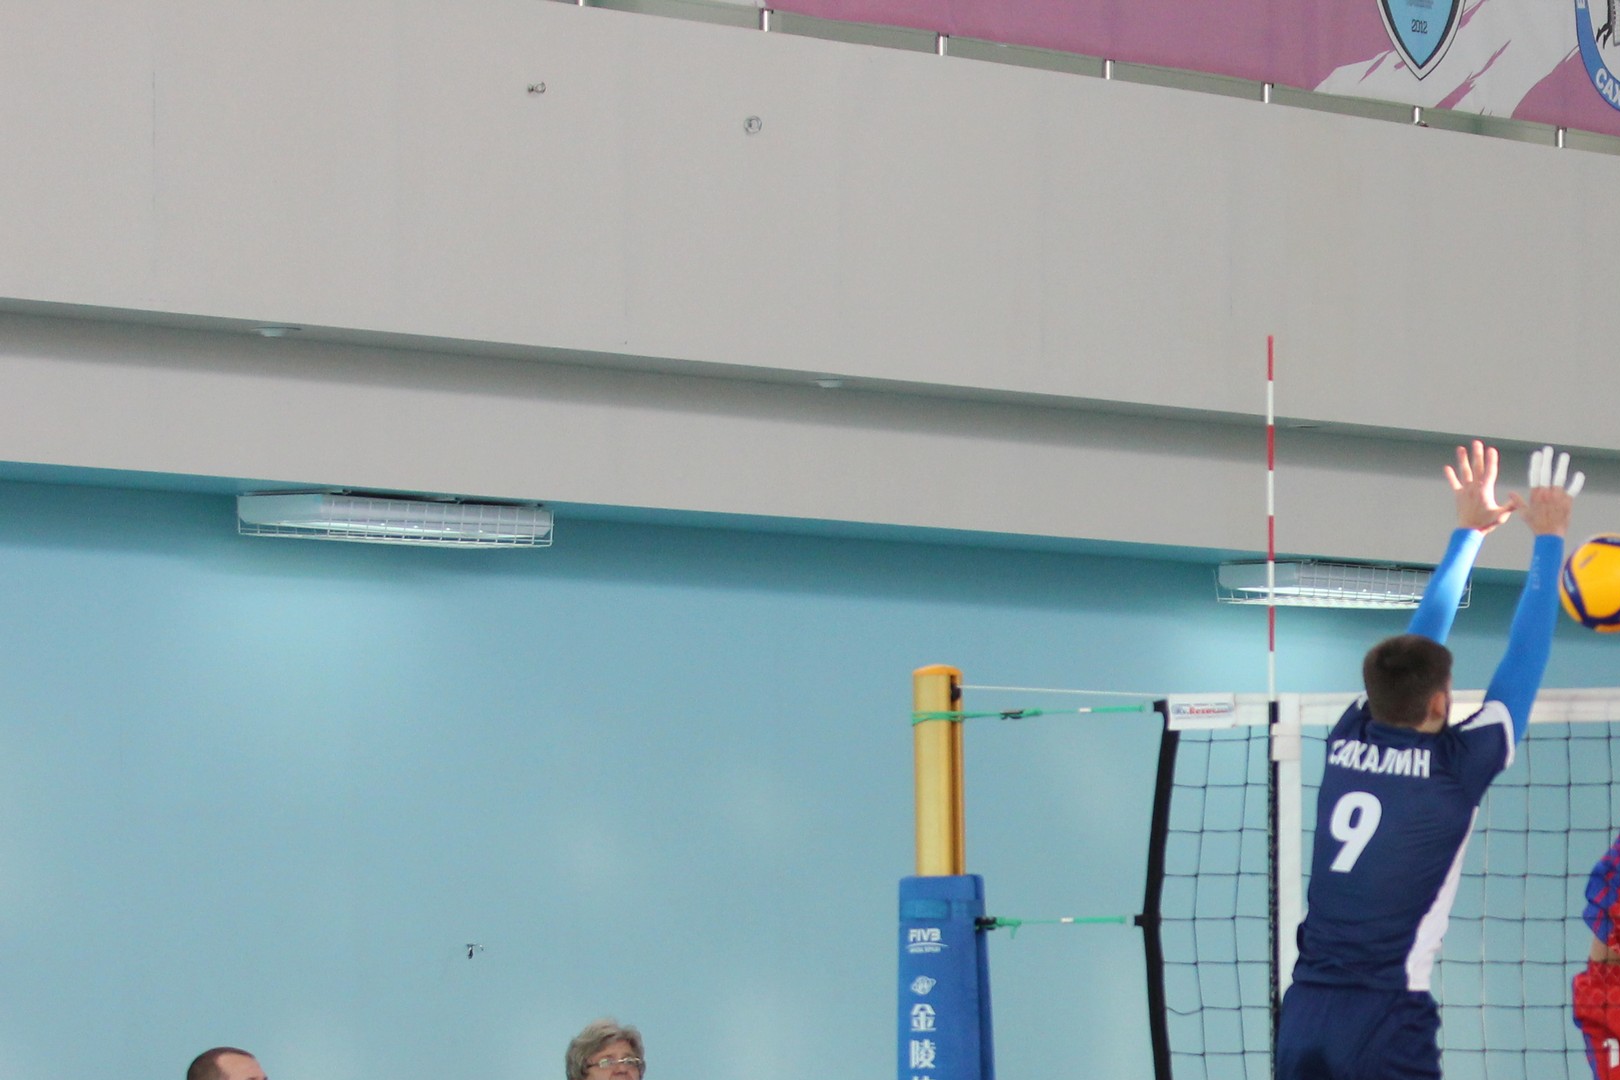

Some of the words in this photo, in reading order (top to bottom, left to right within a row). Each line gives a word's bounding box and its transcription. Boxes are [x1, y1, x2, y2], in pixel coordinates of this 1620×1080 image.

[1411, 19, 1428, 34] 2012
[1328, 739, 1432, 779] САХАЛИН
[1329, 791, 1383, 873] 9
[908, 927, 942, 942] FIVB
